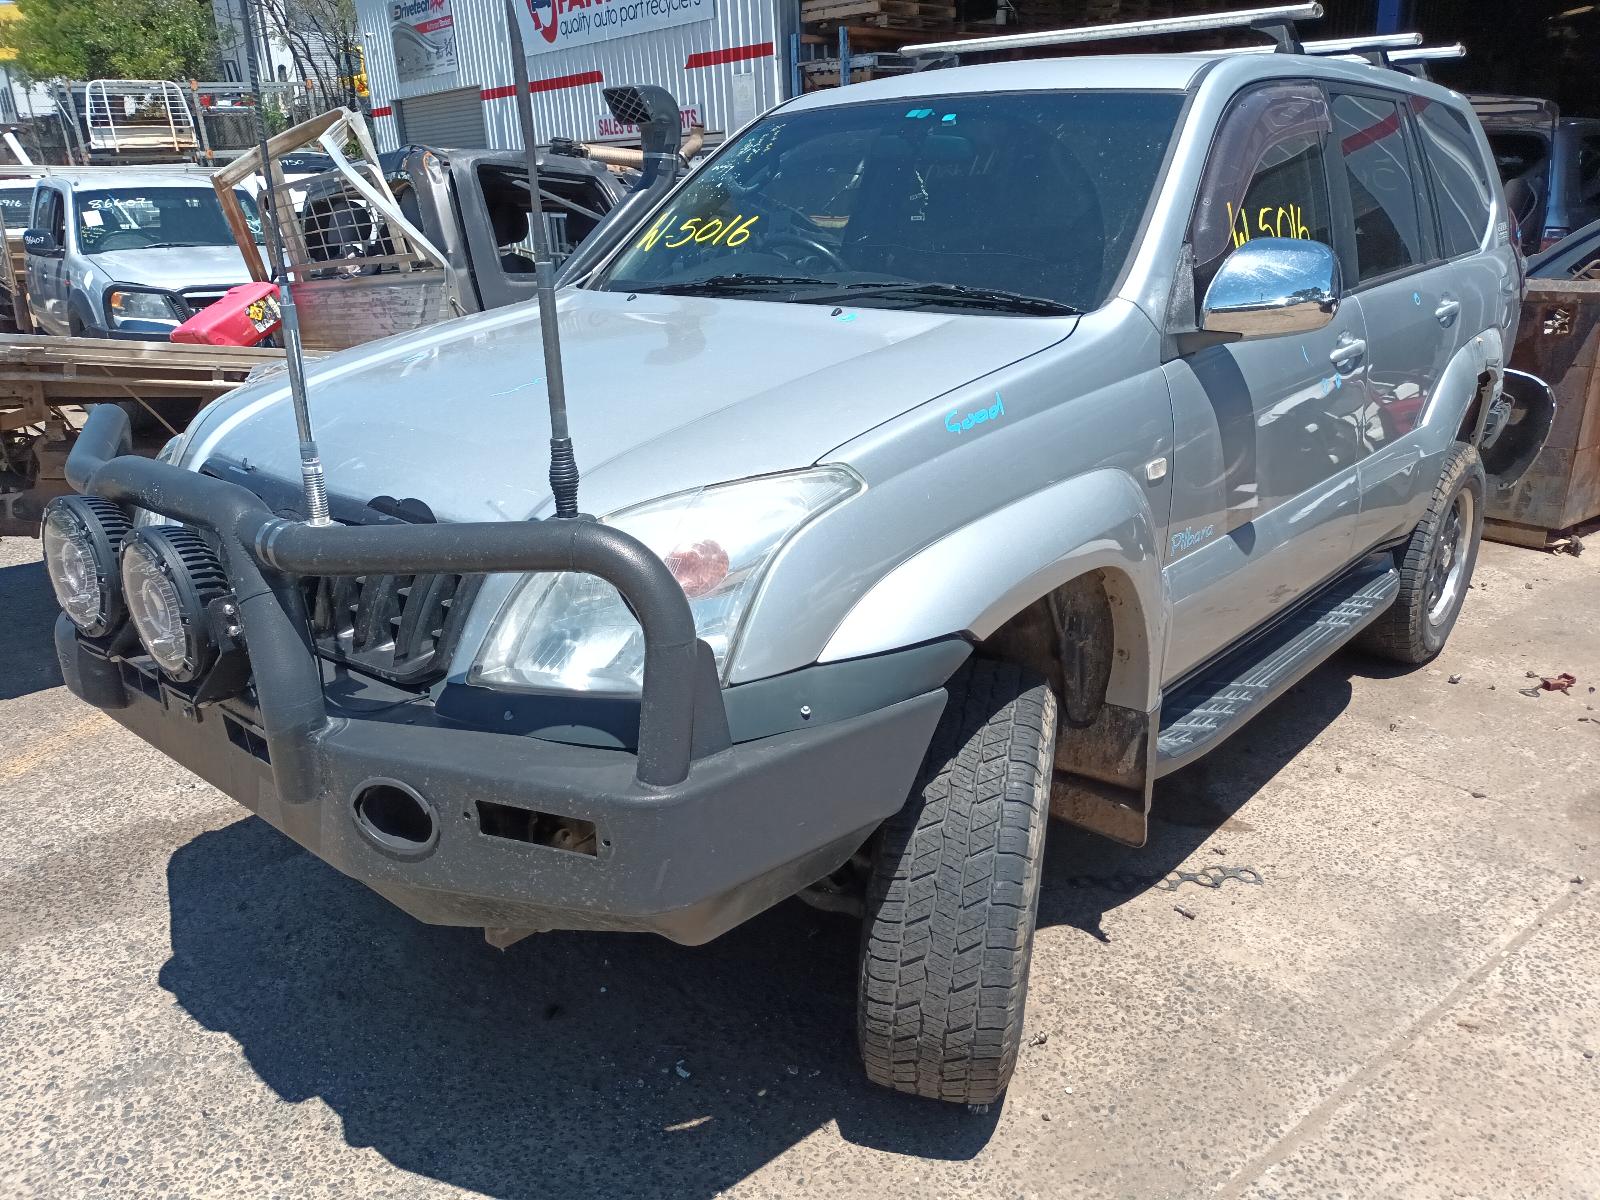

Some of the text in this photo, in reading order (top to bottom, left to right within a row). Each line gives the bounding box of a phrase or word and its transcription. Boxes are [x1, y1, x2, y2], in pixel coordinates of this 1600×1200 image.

[560, 14, 591, 39] quality
[594, 7, 618, 28] auto
[620, 3, 644, 27] part
[88, 197, 150, 209] 86407
